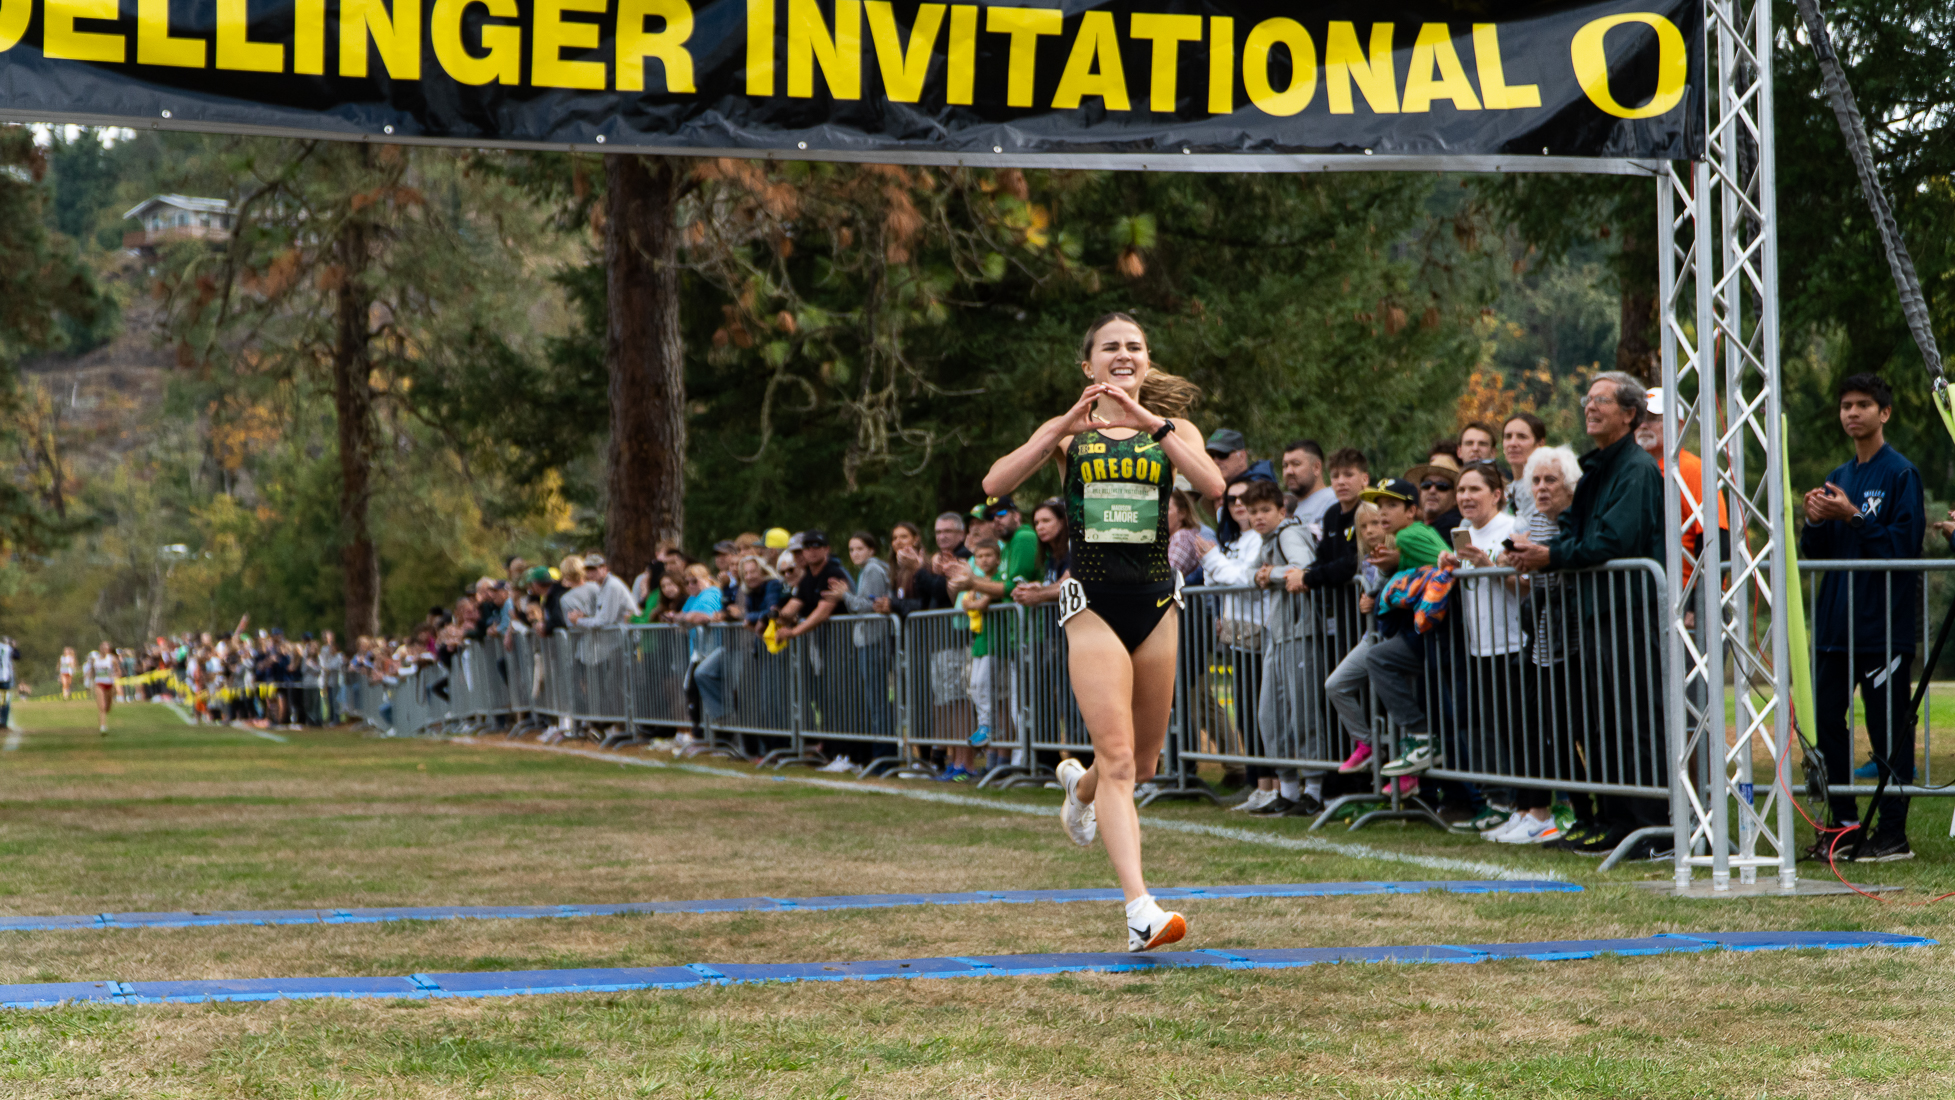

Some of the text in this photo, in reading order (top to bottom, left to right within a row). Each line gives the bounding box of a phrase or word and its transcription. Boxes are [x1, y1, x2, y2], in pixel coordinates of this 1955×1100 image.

[745, 0, 1542, 117] INVITATIONAL
[1571, 11, 1688, 120] O
[1081, 457, 1161, 484] OREGON
[1103, 510, 1139, 523] ELMORE
